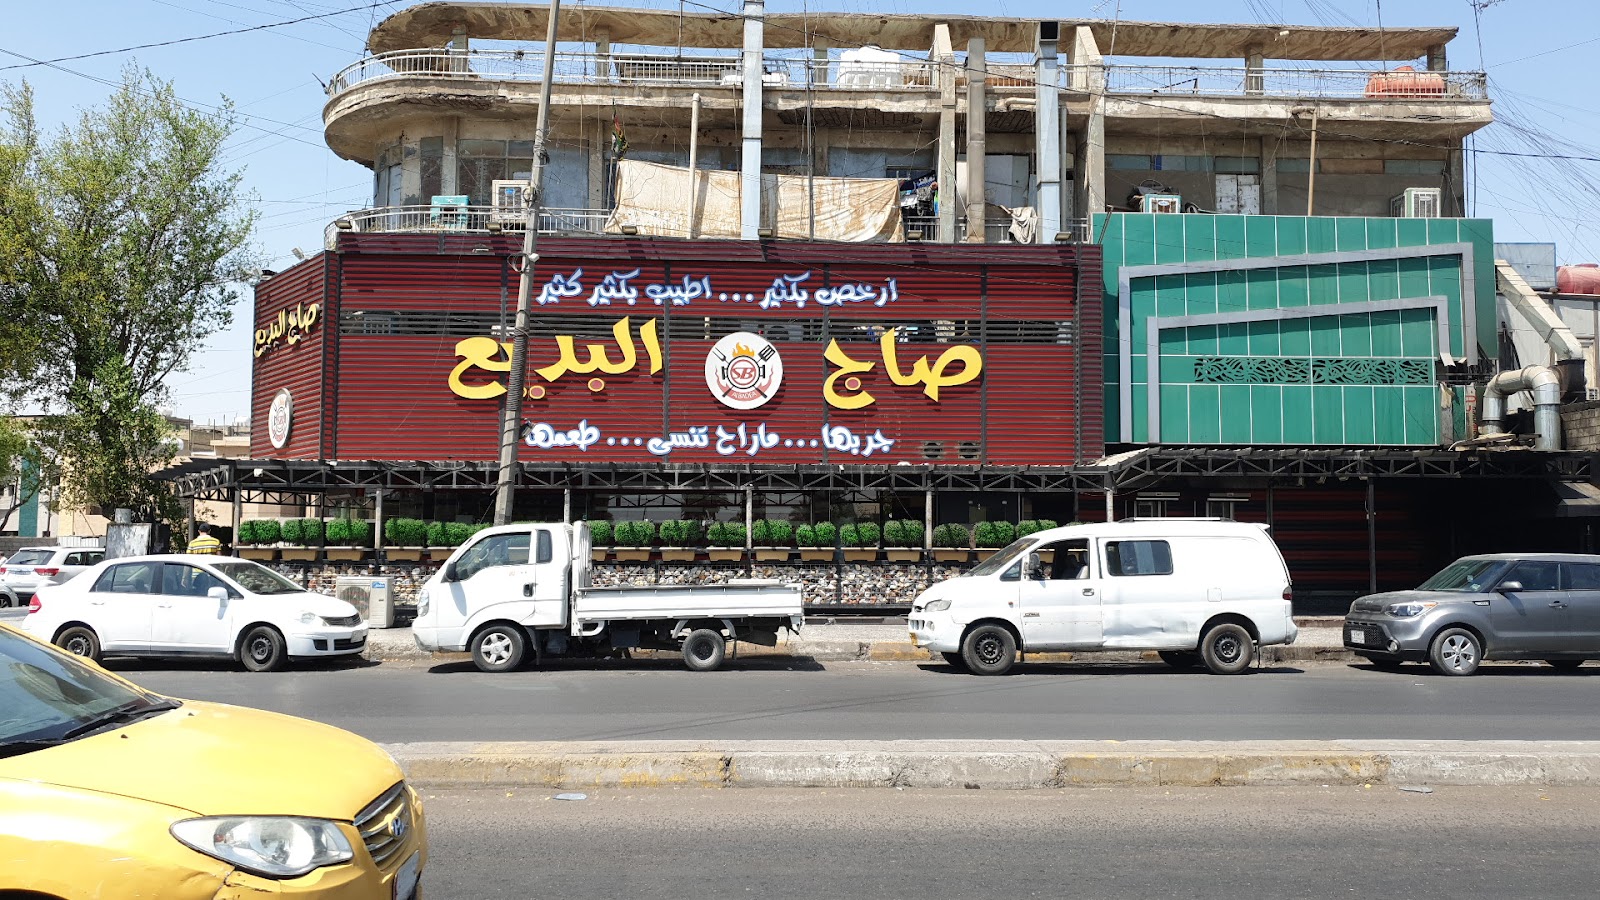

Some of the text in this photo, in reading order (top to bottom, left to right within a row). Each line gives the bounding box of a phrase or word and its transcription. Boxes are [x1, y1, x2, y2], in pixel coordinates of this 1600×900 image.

[536, 266, 584, 307] كثير
[586, 267, 641, 307] بكثير
[645, 274, 713, 306] اطيب
[758, 270, 812, 310] بكثير
[814, 278, 898, 308] ارخص
[823, 327, 983, 410] صاج
[821, 423, 895, 458] جربها
